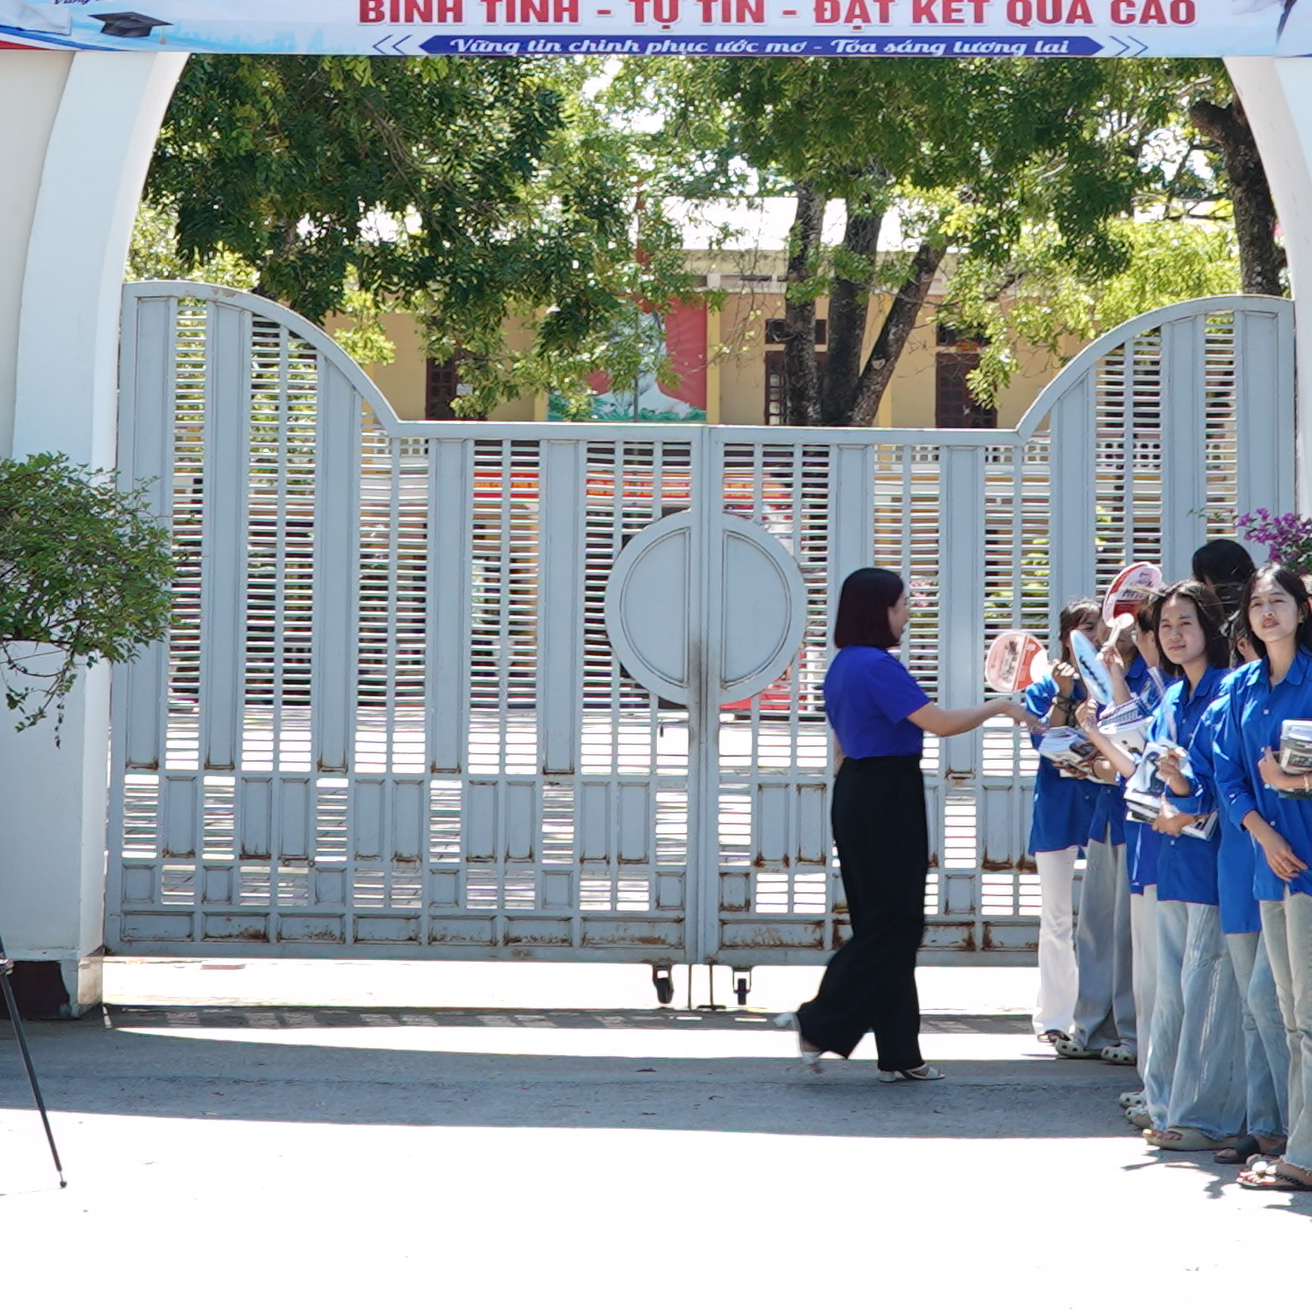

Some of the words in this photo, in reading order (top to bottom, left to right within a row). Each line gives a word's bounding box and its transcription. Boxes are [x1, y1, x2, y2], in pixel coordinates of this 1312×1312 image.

[450, 38, 521, 54] Vững
[527, 38, 562, 52] tin
[568, 39, 639, 52] chinh
[645, 39, 708, 54] phục
[714, 39, 759, 53] ước
[765, 40, 806, 53] mơ
[884, 40, 945, 56] sáng
[953, 40, 1027, 56] tương
[1034, 40, 1070, 53] lai
